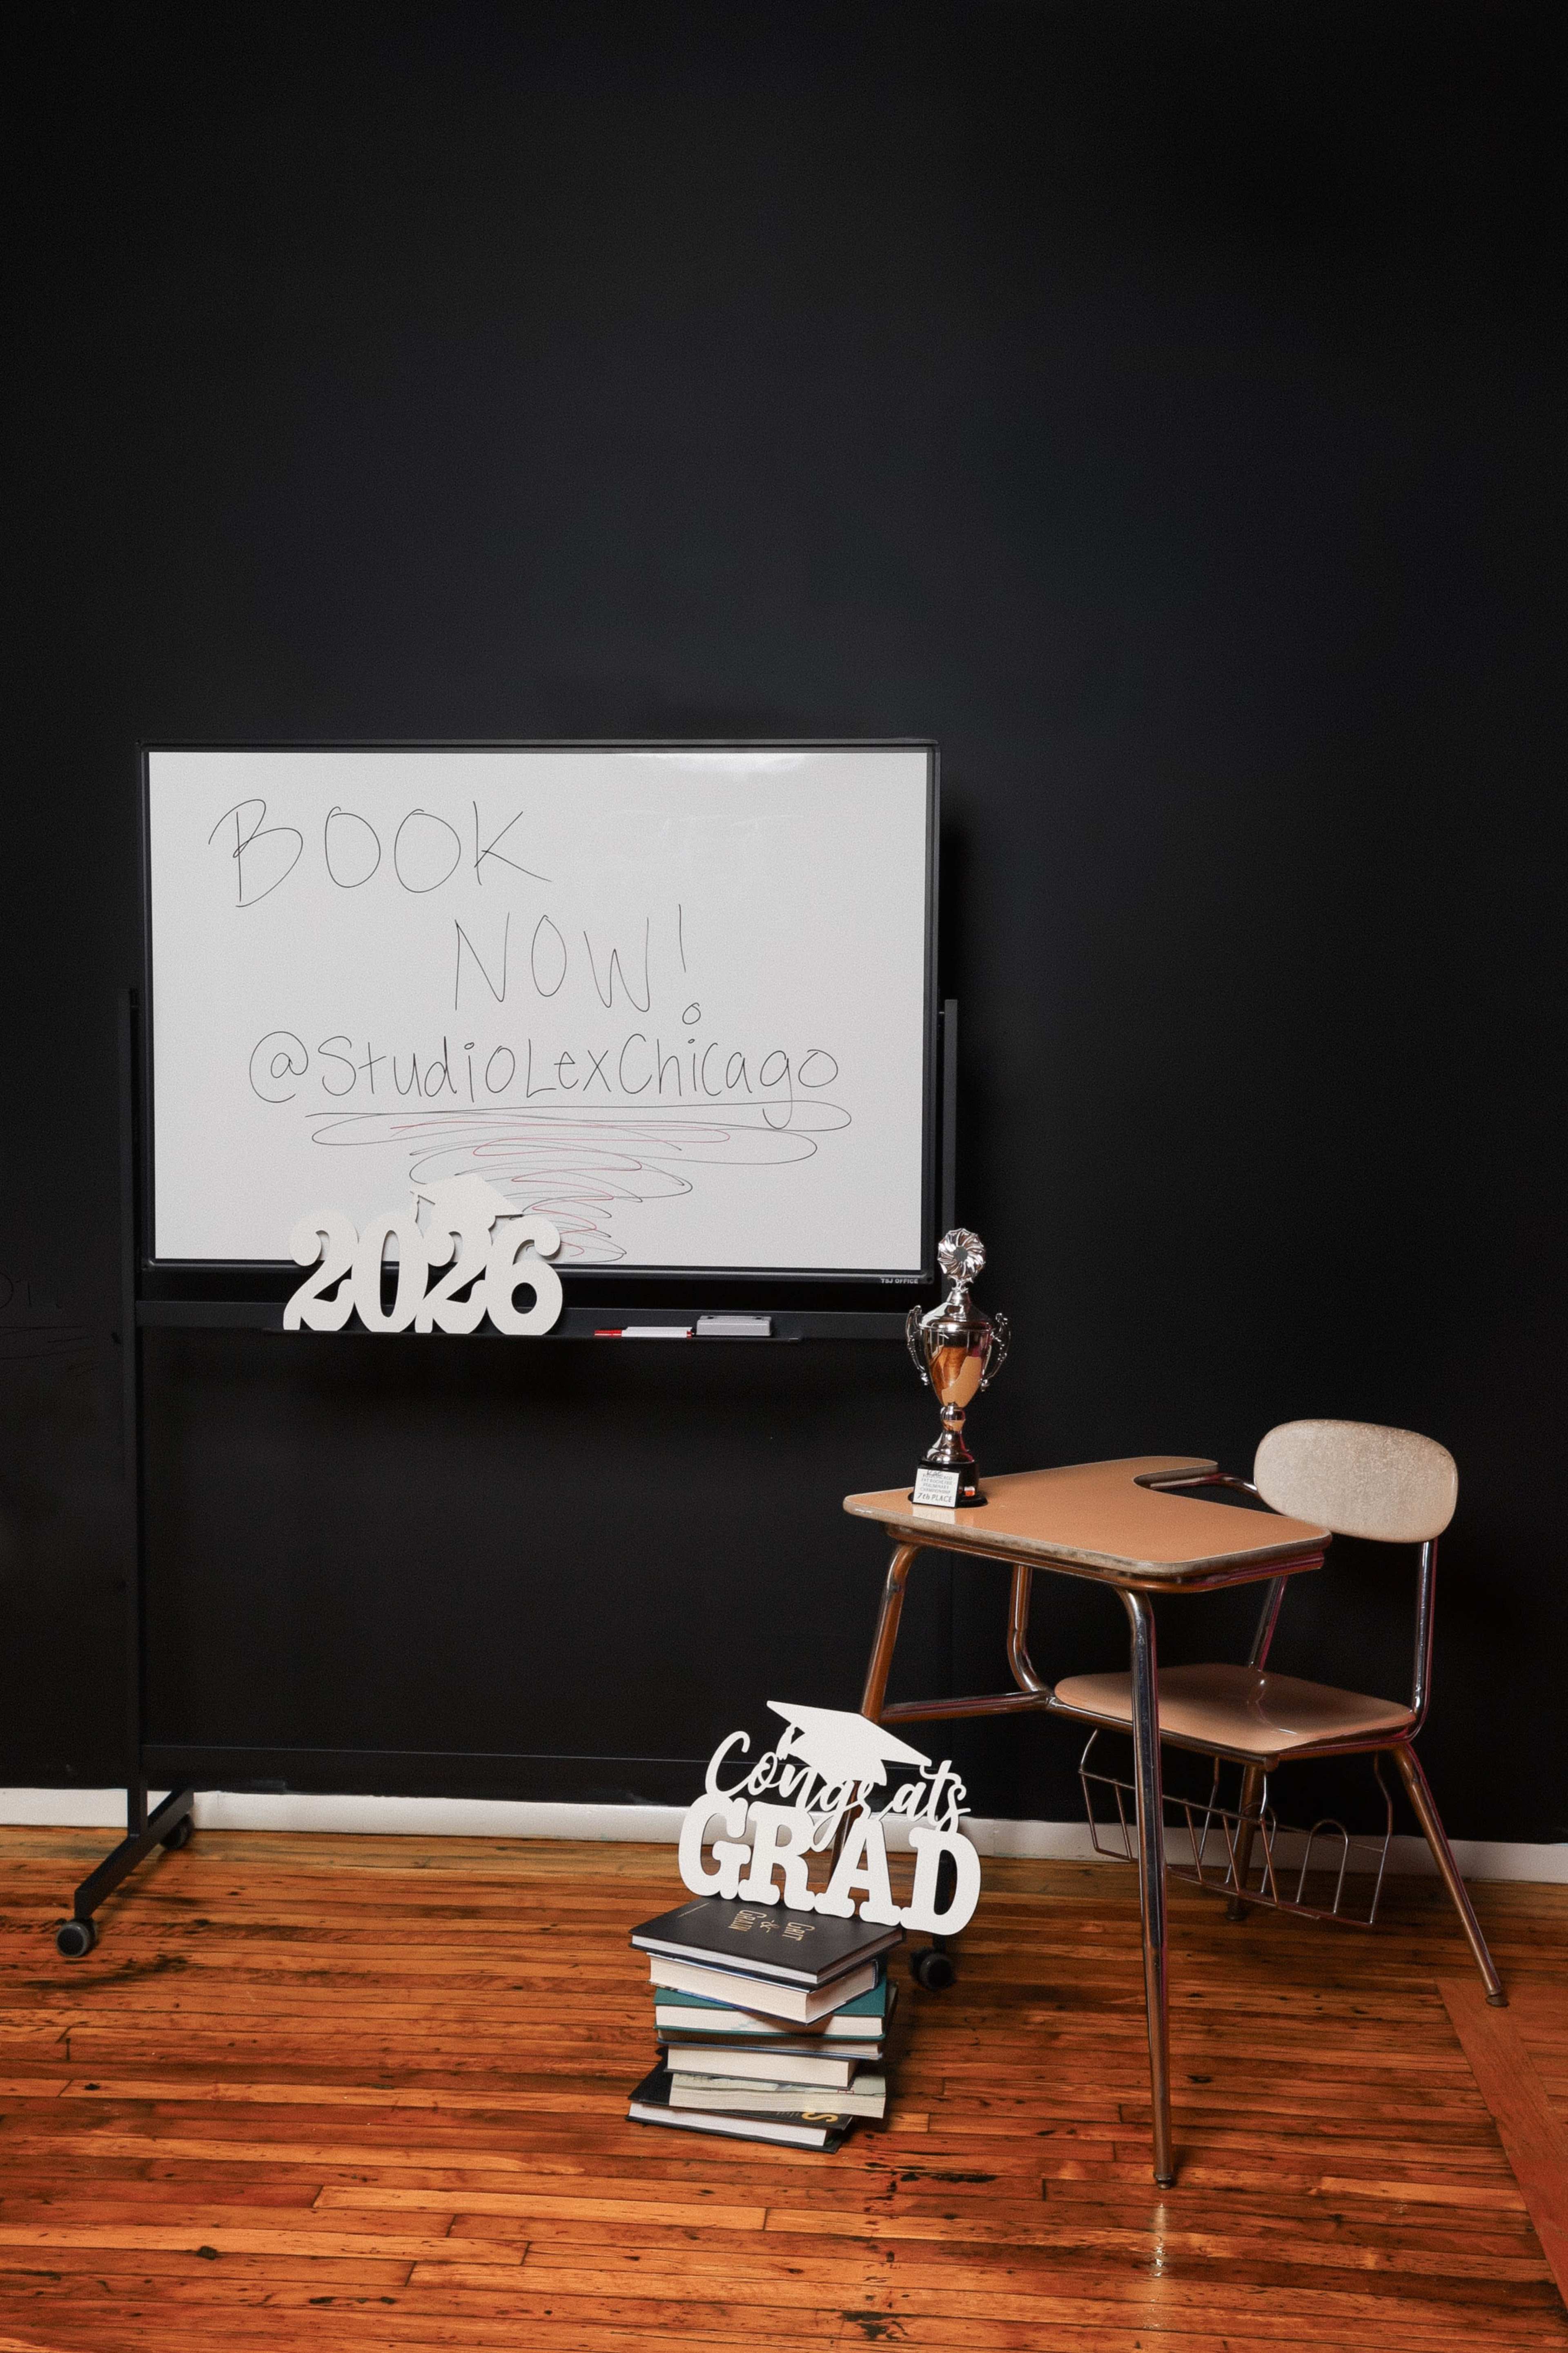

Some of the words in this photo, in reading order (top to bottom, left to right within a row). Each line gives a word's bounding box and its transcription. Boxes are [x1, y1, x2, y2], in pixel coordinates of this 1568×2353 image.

[208, 799, 553, 908] BOOK
[454, 903, 702, 1025] NOW!
[249, 1030, 838, 1129] @StudioLexChicago
[283, 1210, 563, 1336] 2026
[931, 1494, 952, 1502] PLACE
[705, 1731, 971, 1852] Congrats
[678, 1793, 981, 1936] GRAD
[760, 1920, 780, 1933] &
[782, 1922, 815, 1941] GRIT
